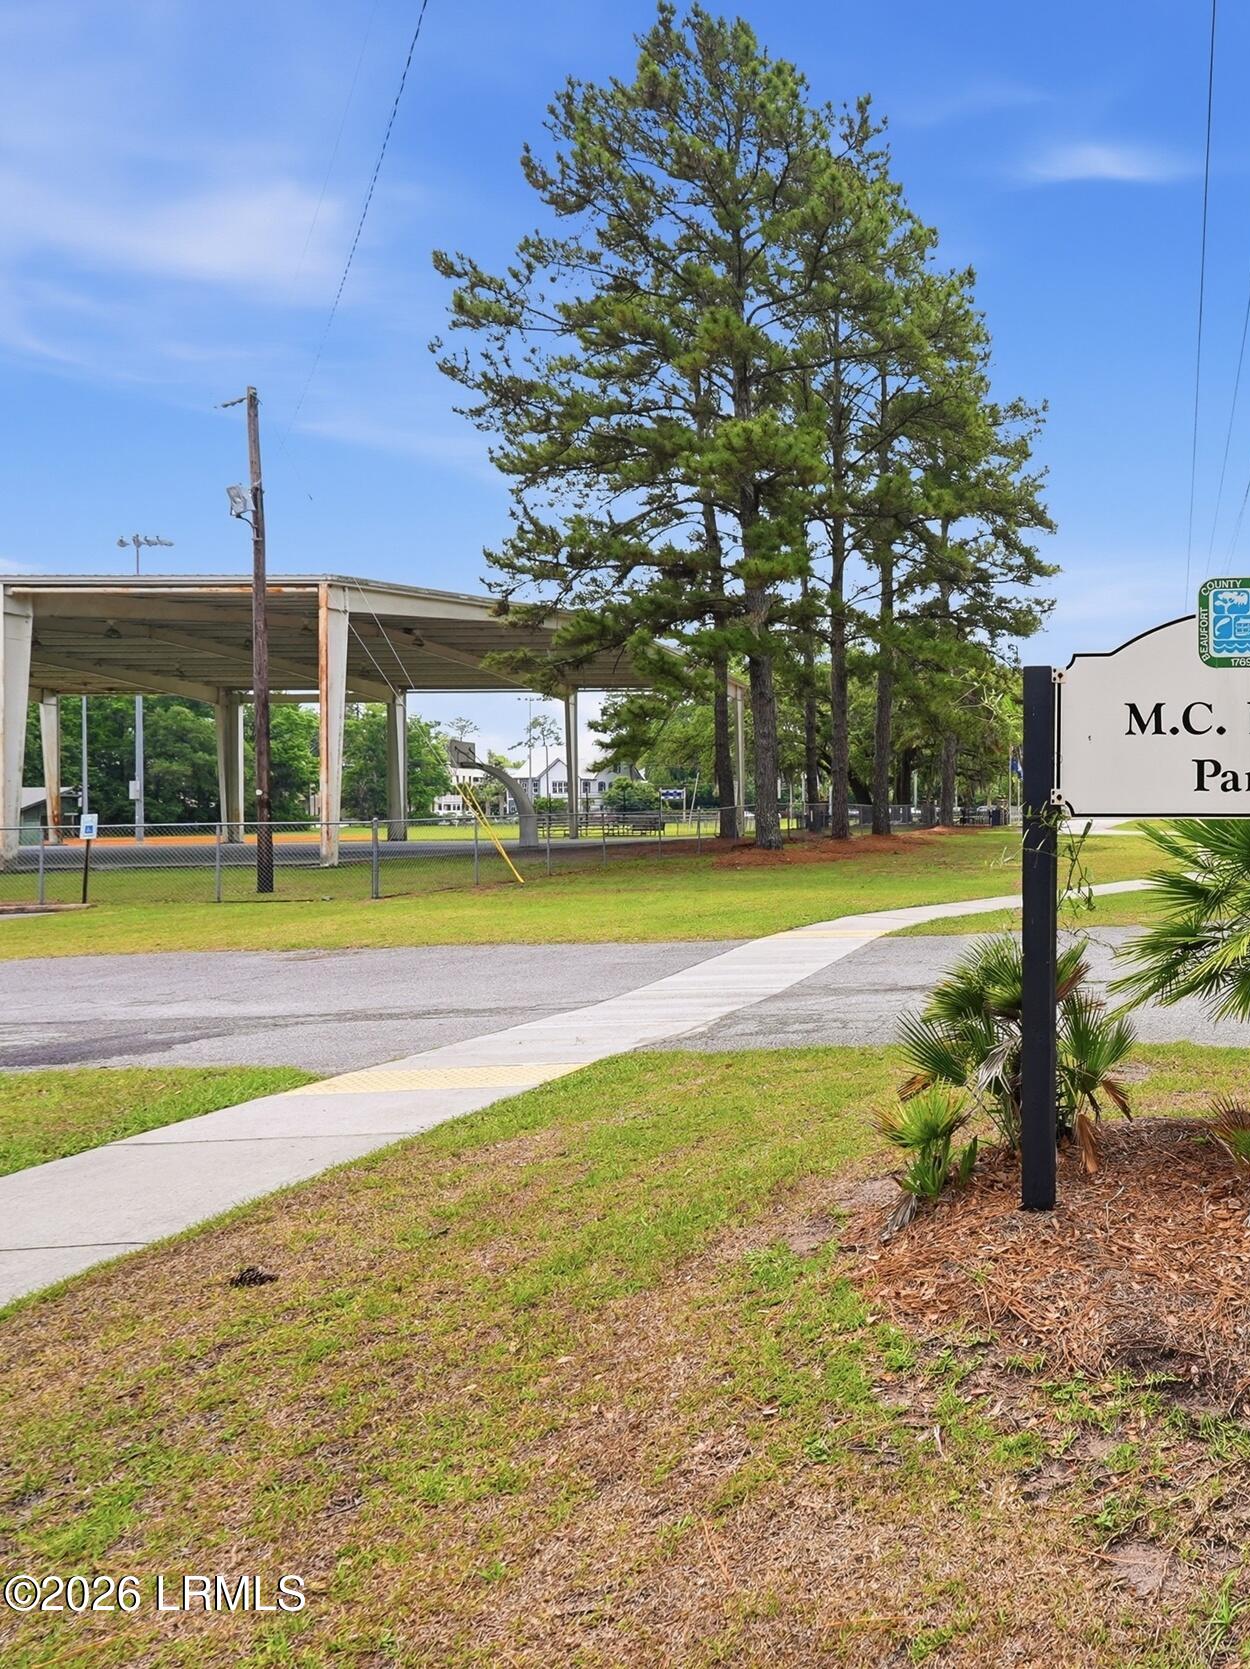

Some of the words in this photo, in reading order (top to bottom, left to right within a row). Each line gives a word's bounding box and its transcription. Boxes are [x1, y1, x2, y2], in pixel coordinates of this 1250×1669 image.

[1201, 579, 1242, 596] COUNTY
[1200, 607, 1211, 662] BEAUFORT
[1124, 701, 1227, 736] M.C.
